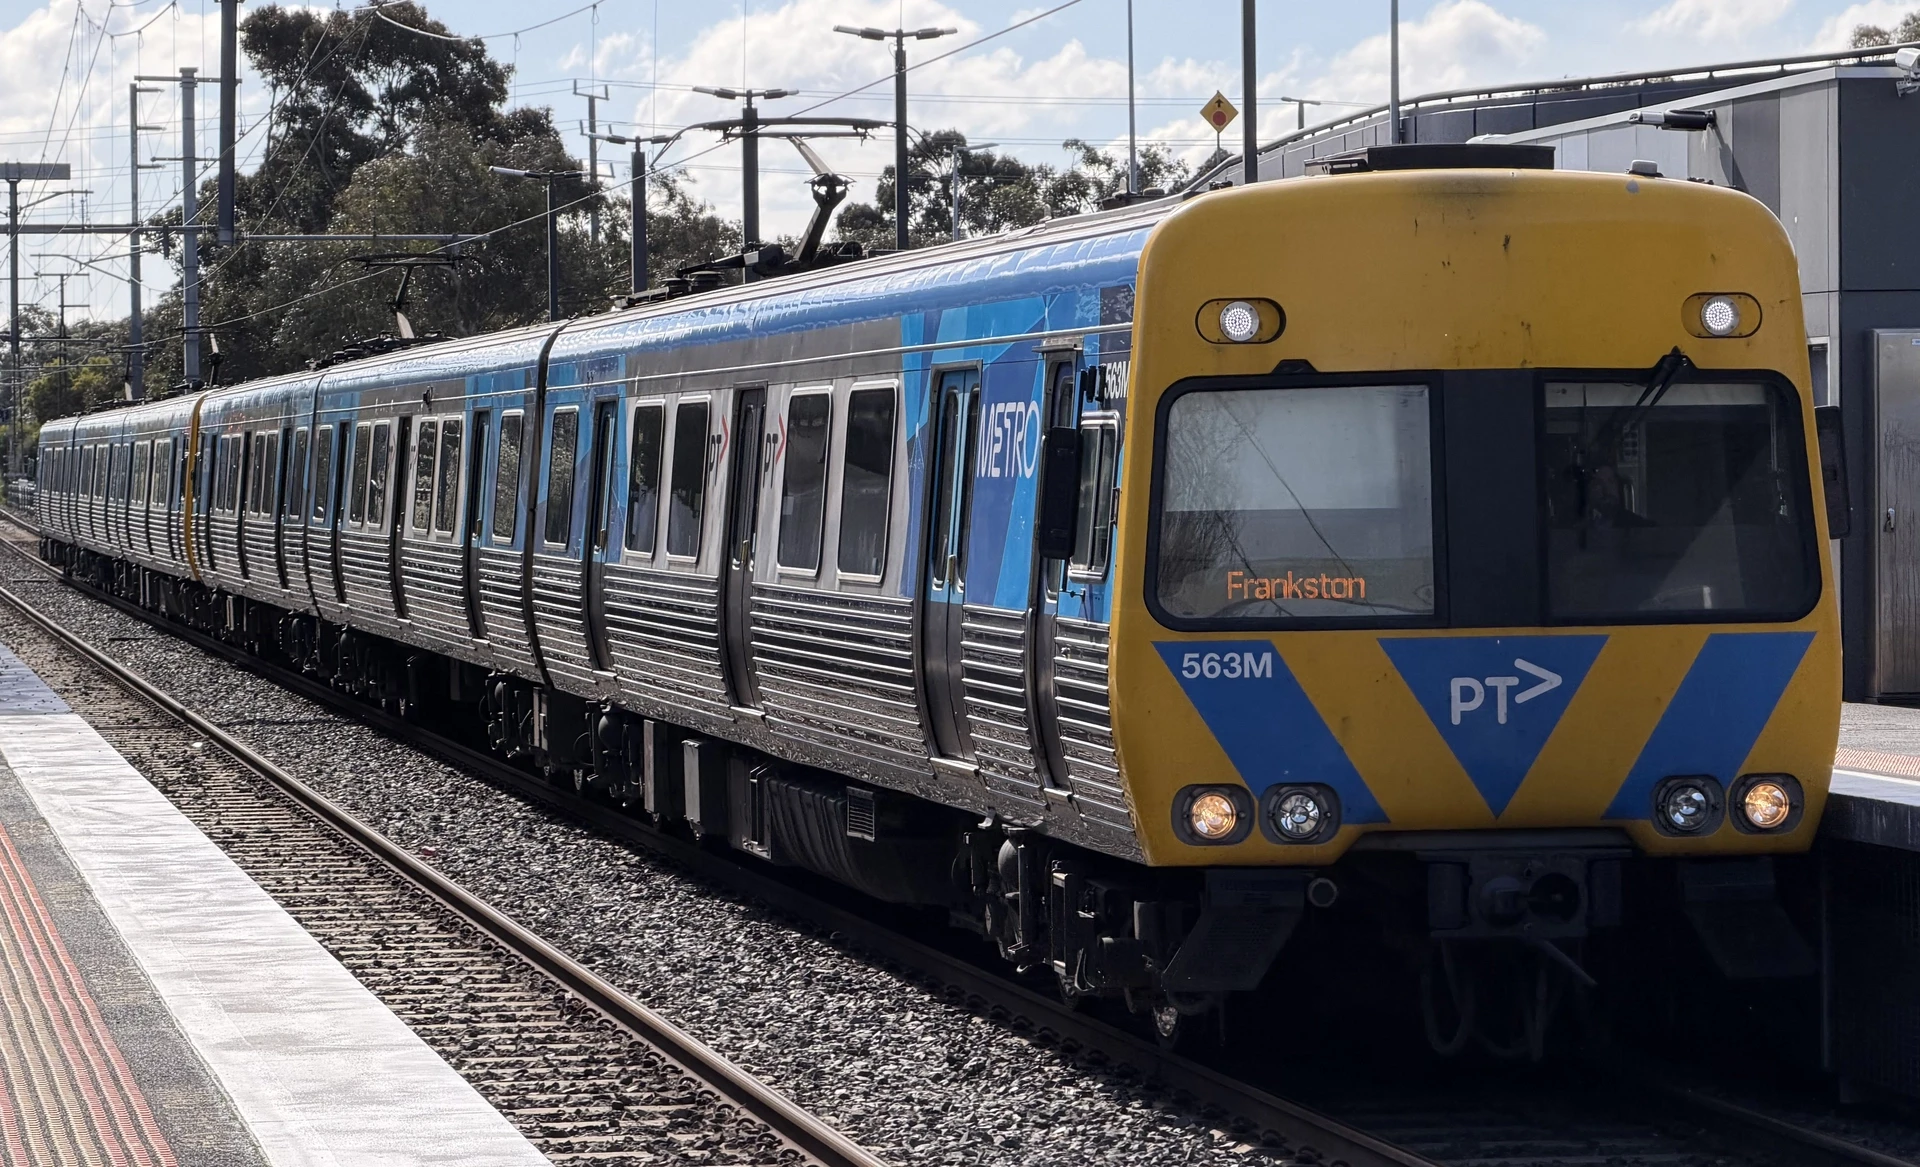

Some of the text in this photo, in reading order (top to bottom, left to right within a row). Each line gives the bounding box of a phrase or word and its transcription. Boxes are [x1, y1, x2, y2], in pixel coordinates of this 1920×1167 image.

[1104, 361, 1131, 399] 563M
[976, 400, 1040, 479] METRO
[1227, 570, 1366, 600] Frankston
[1181, 652, 1272, 680] 563M
